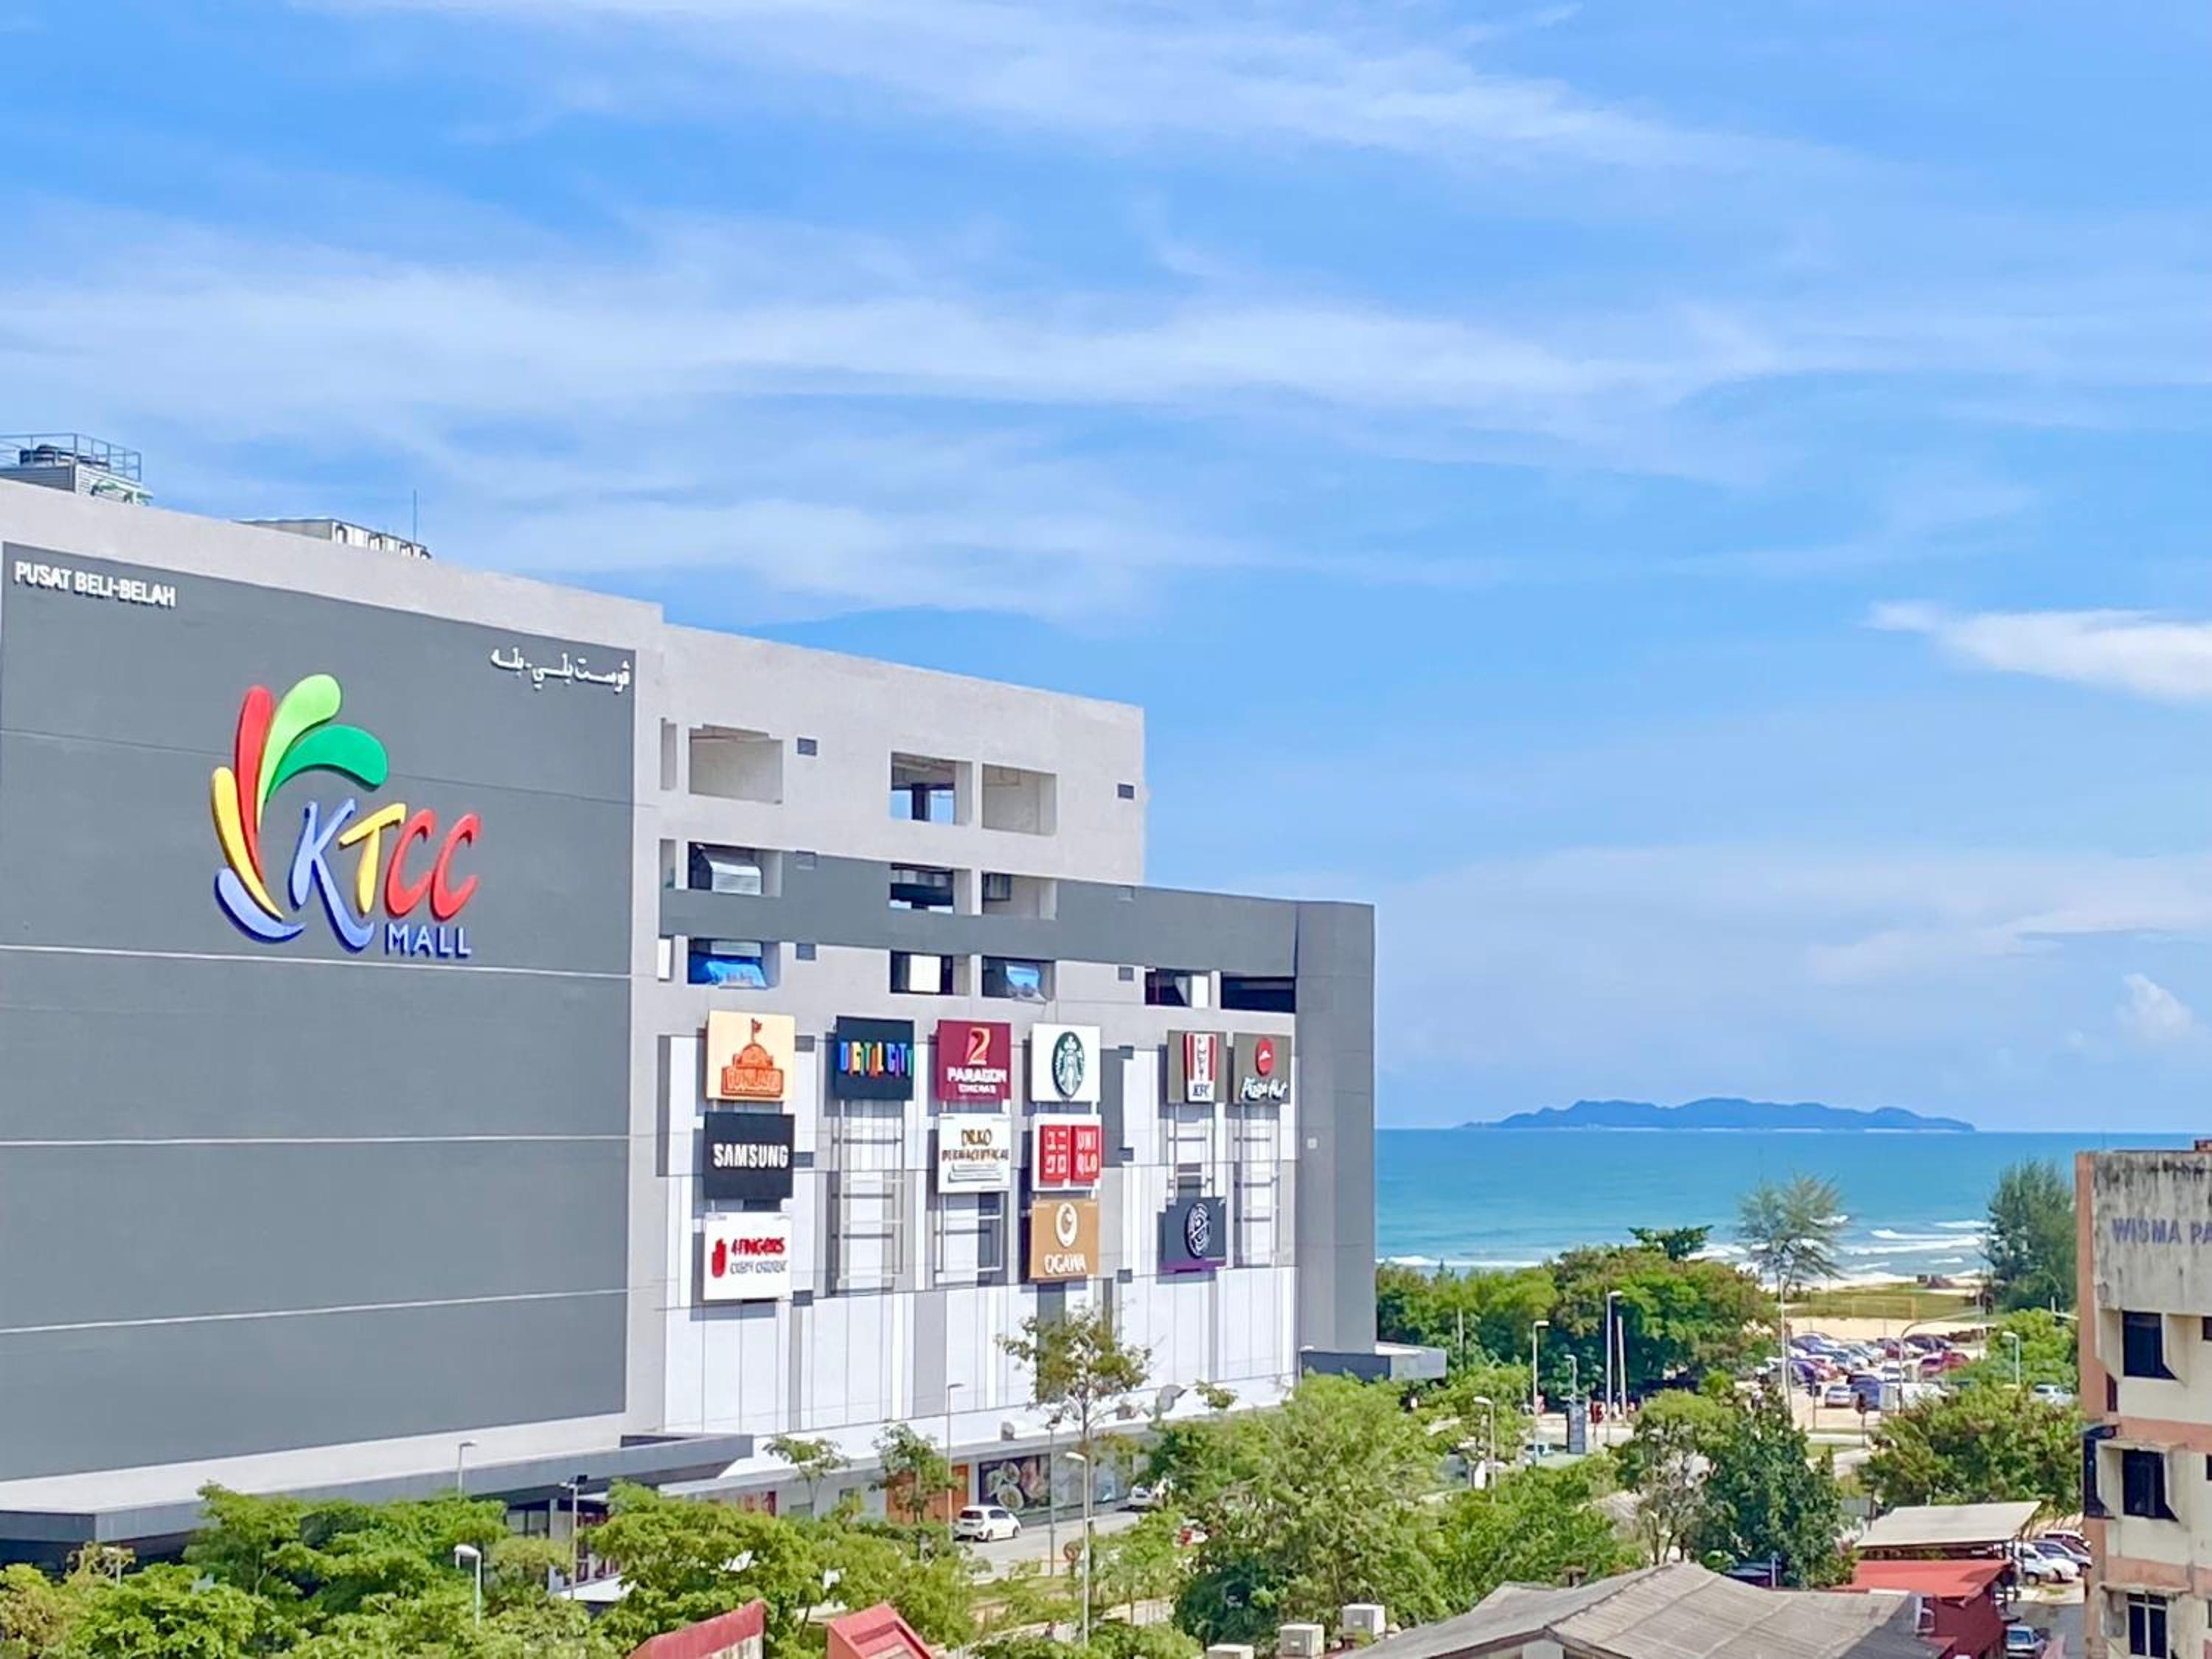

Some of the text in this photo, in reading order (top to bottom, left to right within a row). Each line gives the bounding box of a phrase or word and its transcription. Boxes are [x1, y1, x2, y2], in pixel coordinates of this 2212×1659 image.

[13, 561, 176, 608] PUSAT BELI-BELAH
[289, 798, 481, 953] KTCC
[386, 923, 472, 958] MALL
[947, 1067, 1006, 1084] PARAGON
[1193, 1083, 1211, 1097] KFC
[1077, 1130, 1096, 1150] UNI
[713, 1144, 789, 1168] SAMSUNG
[1077, 1153, 1098, 1175] QLO
[2111, 1217, 2183, 1244] WISMA
[1044, 1253, 1086, 1274] OGAWA
